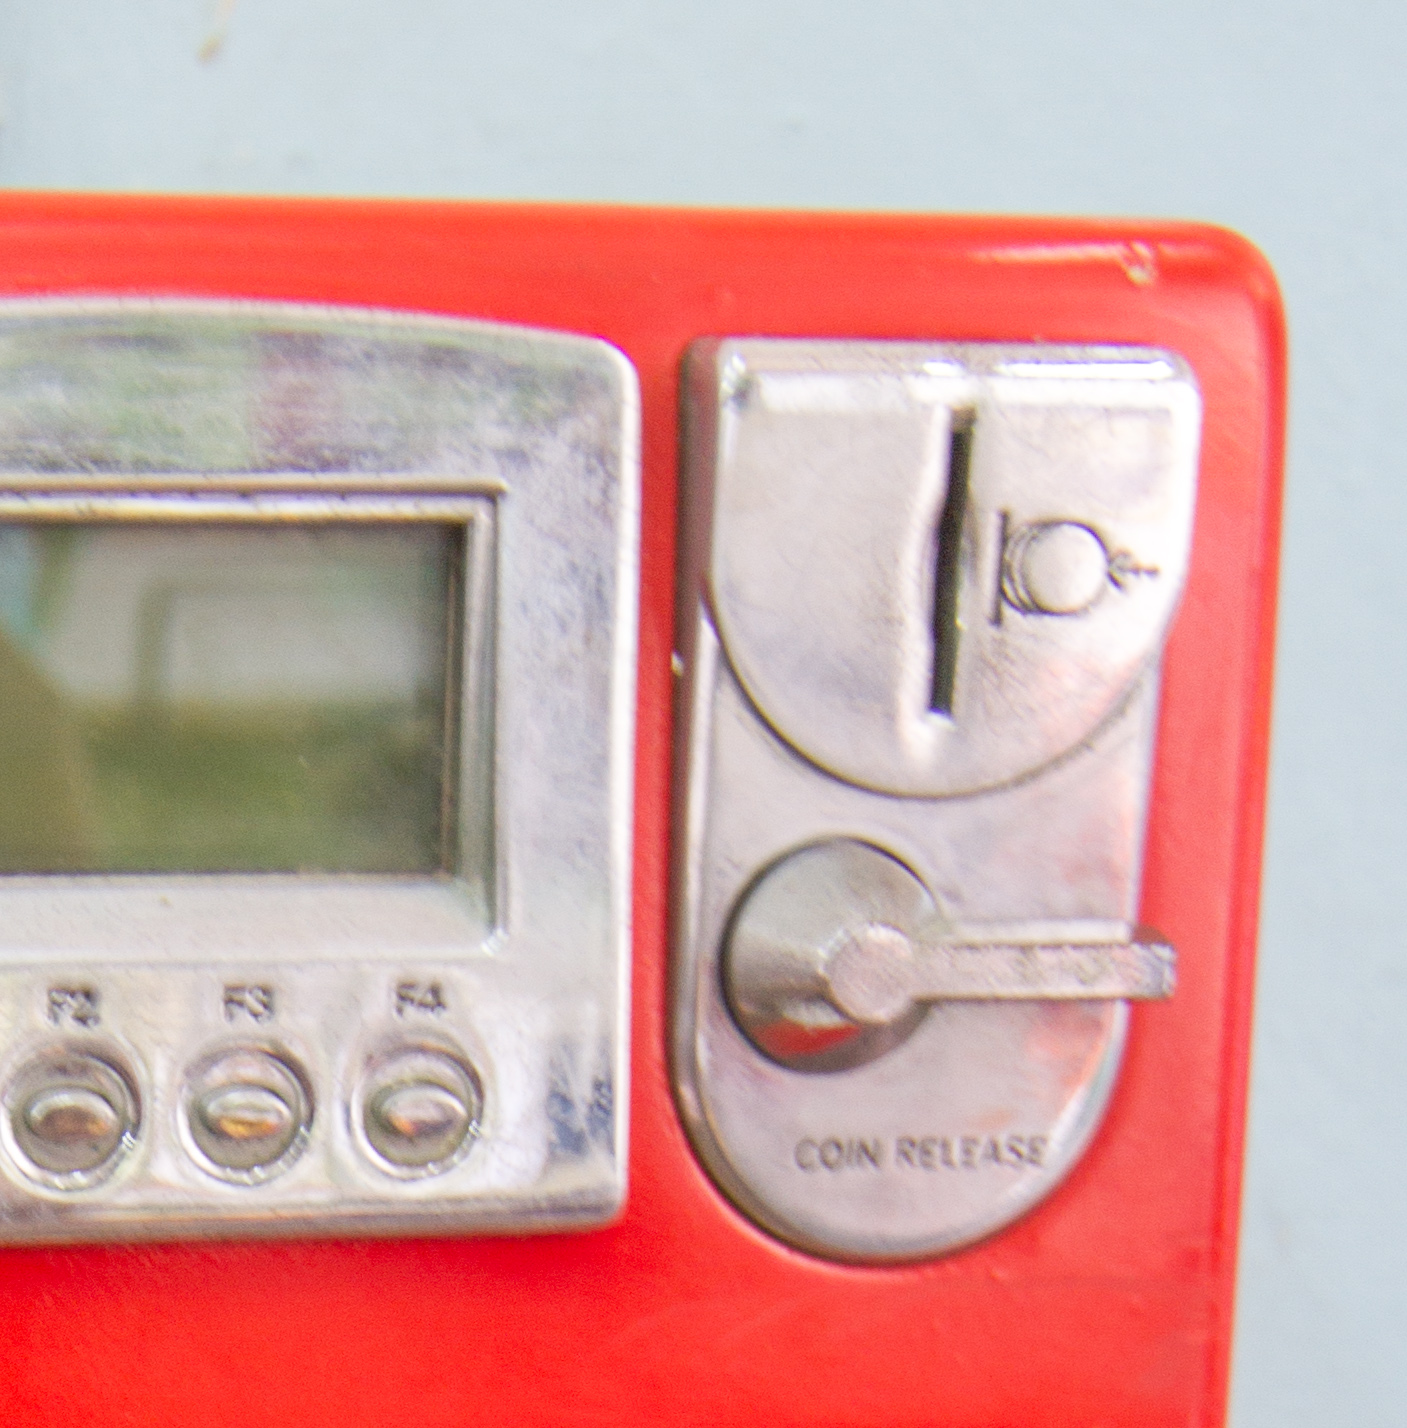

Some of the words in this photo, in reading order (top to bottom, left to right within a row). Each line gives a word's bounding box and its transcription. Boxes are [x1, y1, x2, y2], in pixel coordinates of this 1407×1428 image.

[48, 983, 100, 1026] F2
[396, 980, 446, 1016] F4
[793, 1137, 882, 1172] COIN
[894, 1134, 1050, 1170] RELEASE
